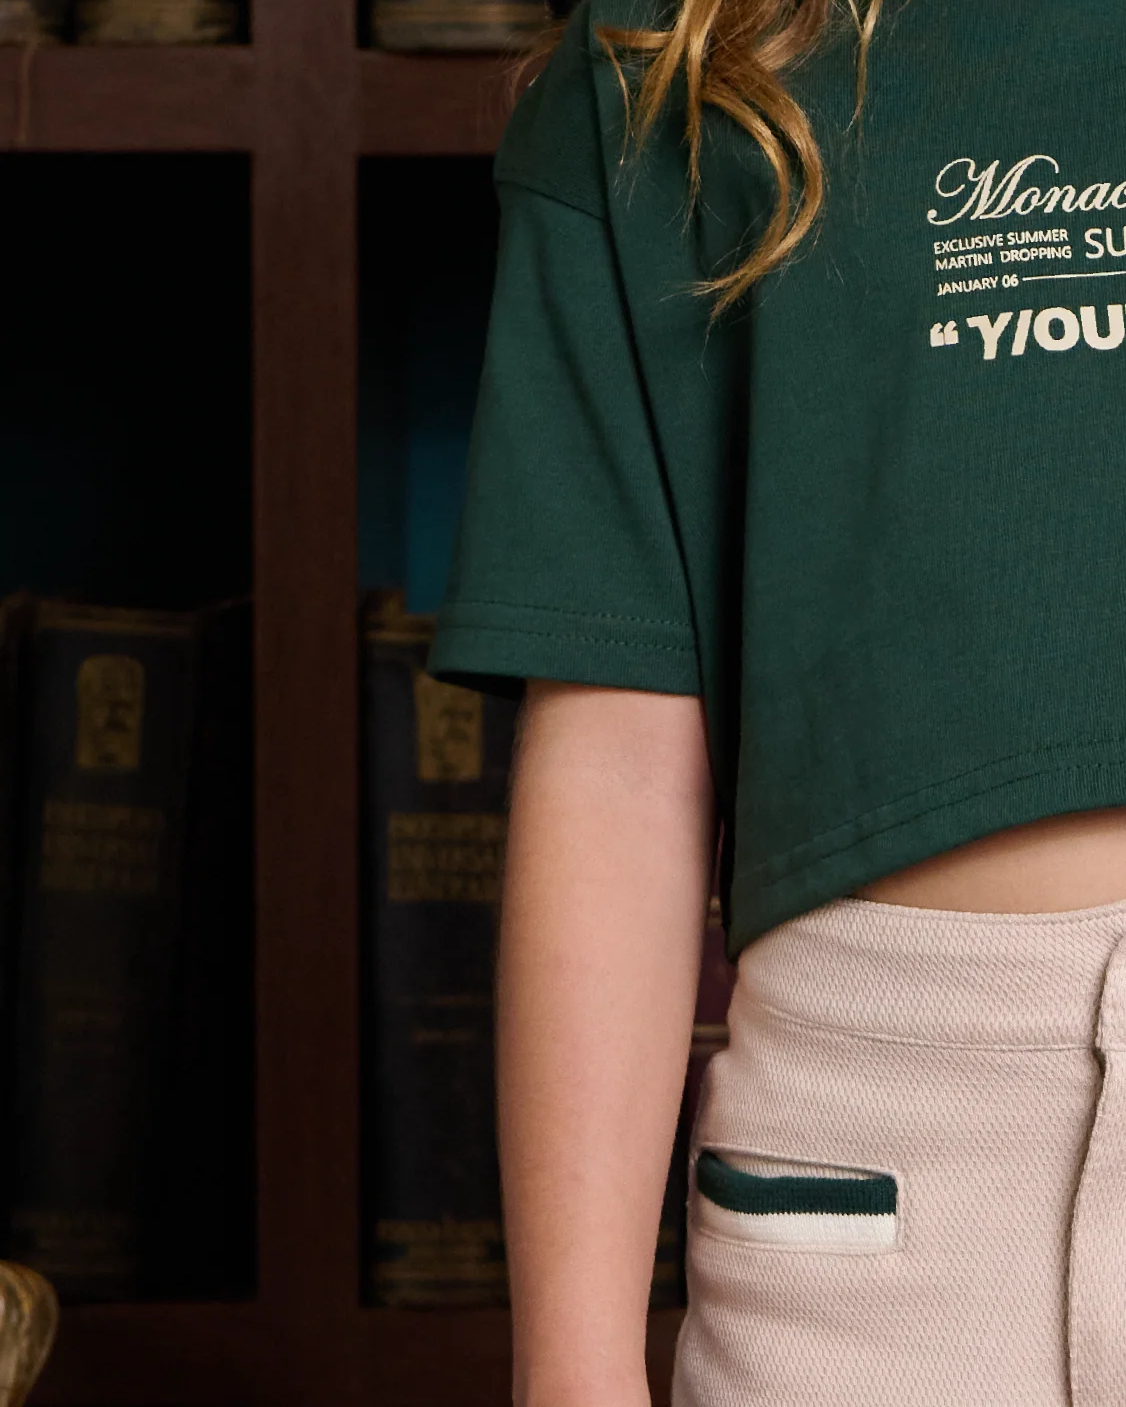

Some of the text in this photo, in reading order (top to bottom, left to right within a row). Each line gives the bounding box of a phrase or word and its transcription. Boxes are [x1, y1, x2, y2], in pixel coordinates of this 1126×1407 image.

[933, 228, 1069, 255] EXCLUSIVE SUMMER
[935, 245, 1073, 272] MARTINI DROPPING
[937, 275, 999, 297] JANUARY
[1001, 273, 1020, 289] 06
